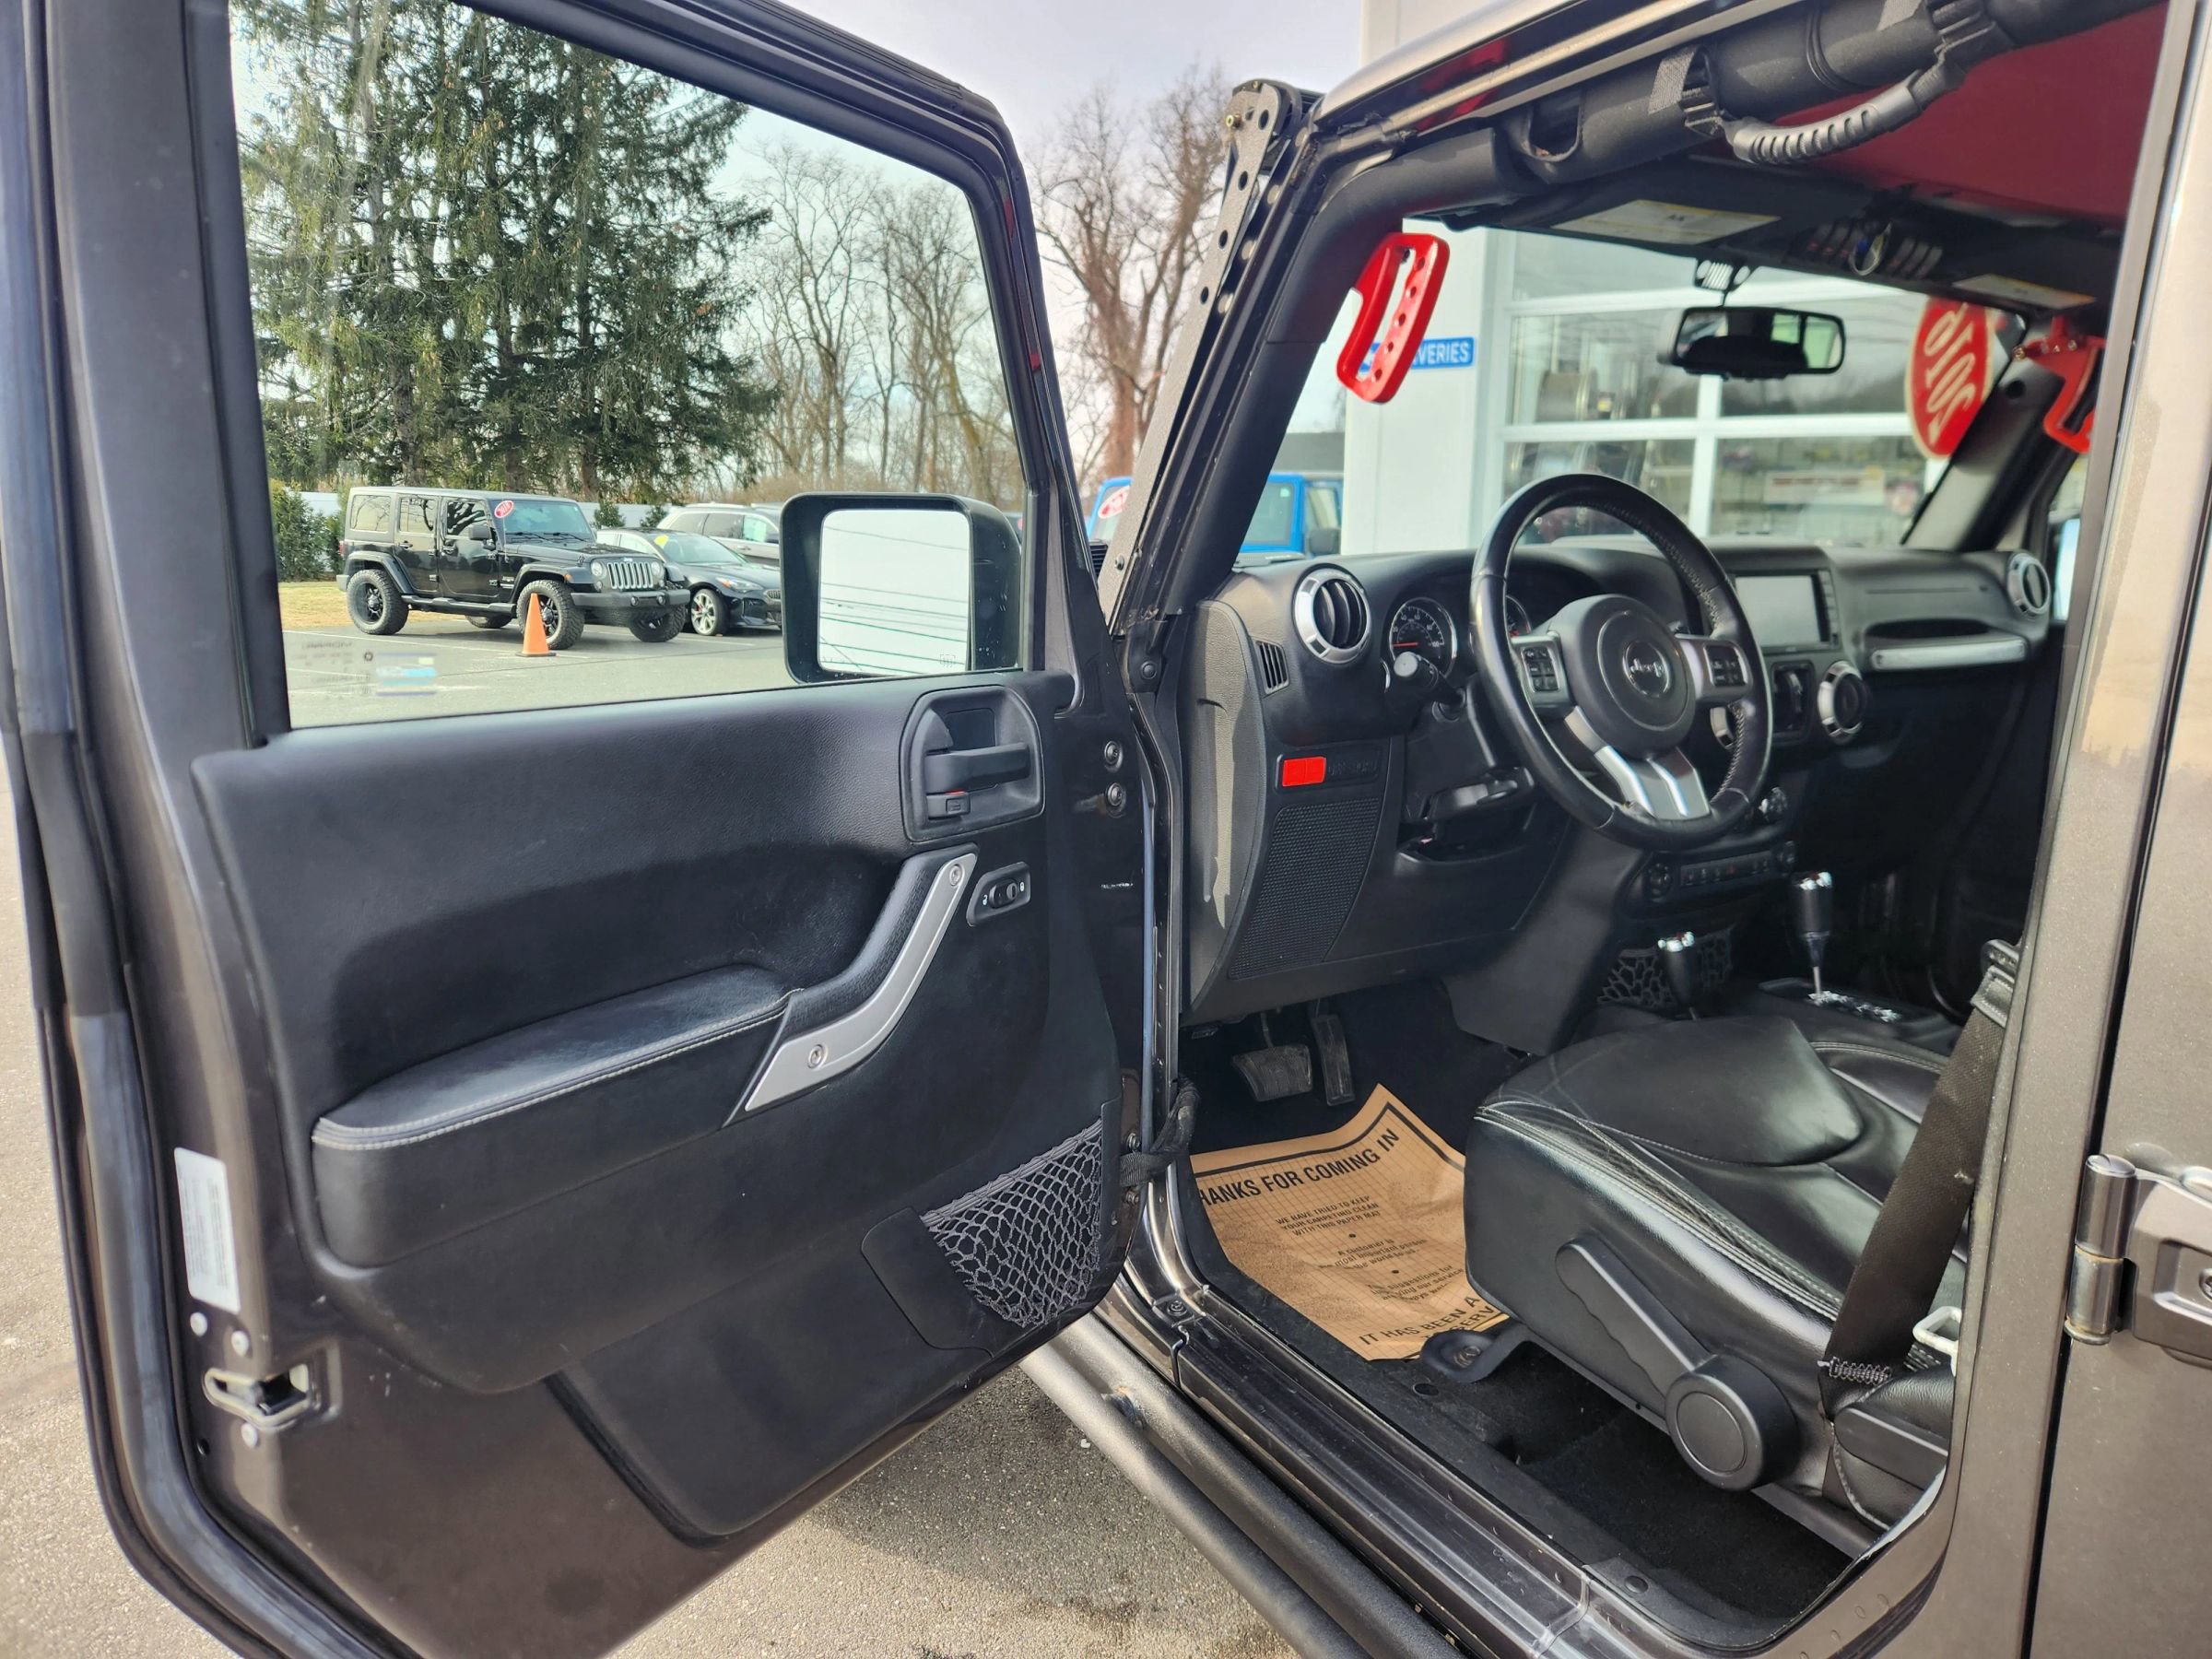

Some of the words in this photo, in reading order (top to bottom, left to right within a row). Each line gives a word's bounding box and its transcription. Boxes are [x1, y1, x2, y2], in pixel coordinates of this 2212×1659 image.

[1415, 341, 1470, 365] VERIES
[1199, 1179, 1262, 1206] HANKS
[1260, 1171, 1304, 1193] FOR
[1302, 1147, 1382, 1182] COMING
[1376, 1127, 1400, 1152] IN
[1276, 1217, 1289, 1225] WE
[1290, 1211, 1313, 1221] HAVE
[1313, 1204, 1338, 1216] TRIED
[1350, 1195, 1371, 1205] KEEP
[1281, 1220, 1306, 1230] YOUR
[1352, 1202, 1380, 1213] CLEAN
[1291, 1226, 1316, 1236] WITH
[1316, 1221, 1336, 1230] THIS
[1335, 1214, 1364, 1226] PAPER
[1363, 1210, 1382, 1218] MAT
[1334, 1254, 1357, 1267] most
[1346, 1241, 1384, 1254] customer
[1359, 1333, 1379, 1345] IT
[1380, 1326, 1420, 1338] HAS
[1420, 1309, 1467, 1330] BEEN
[1464, 1296, 1480, 1308] A
[1449, 1305, 1495, 1331] SERV
